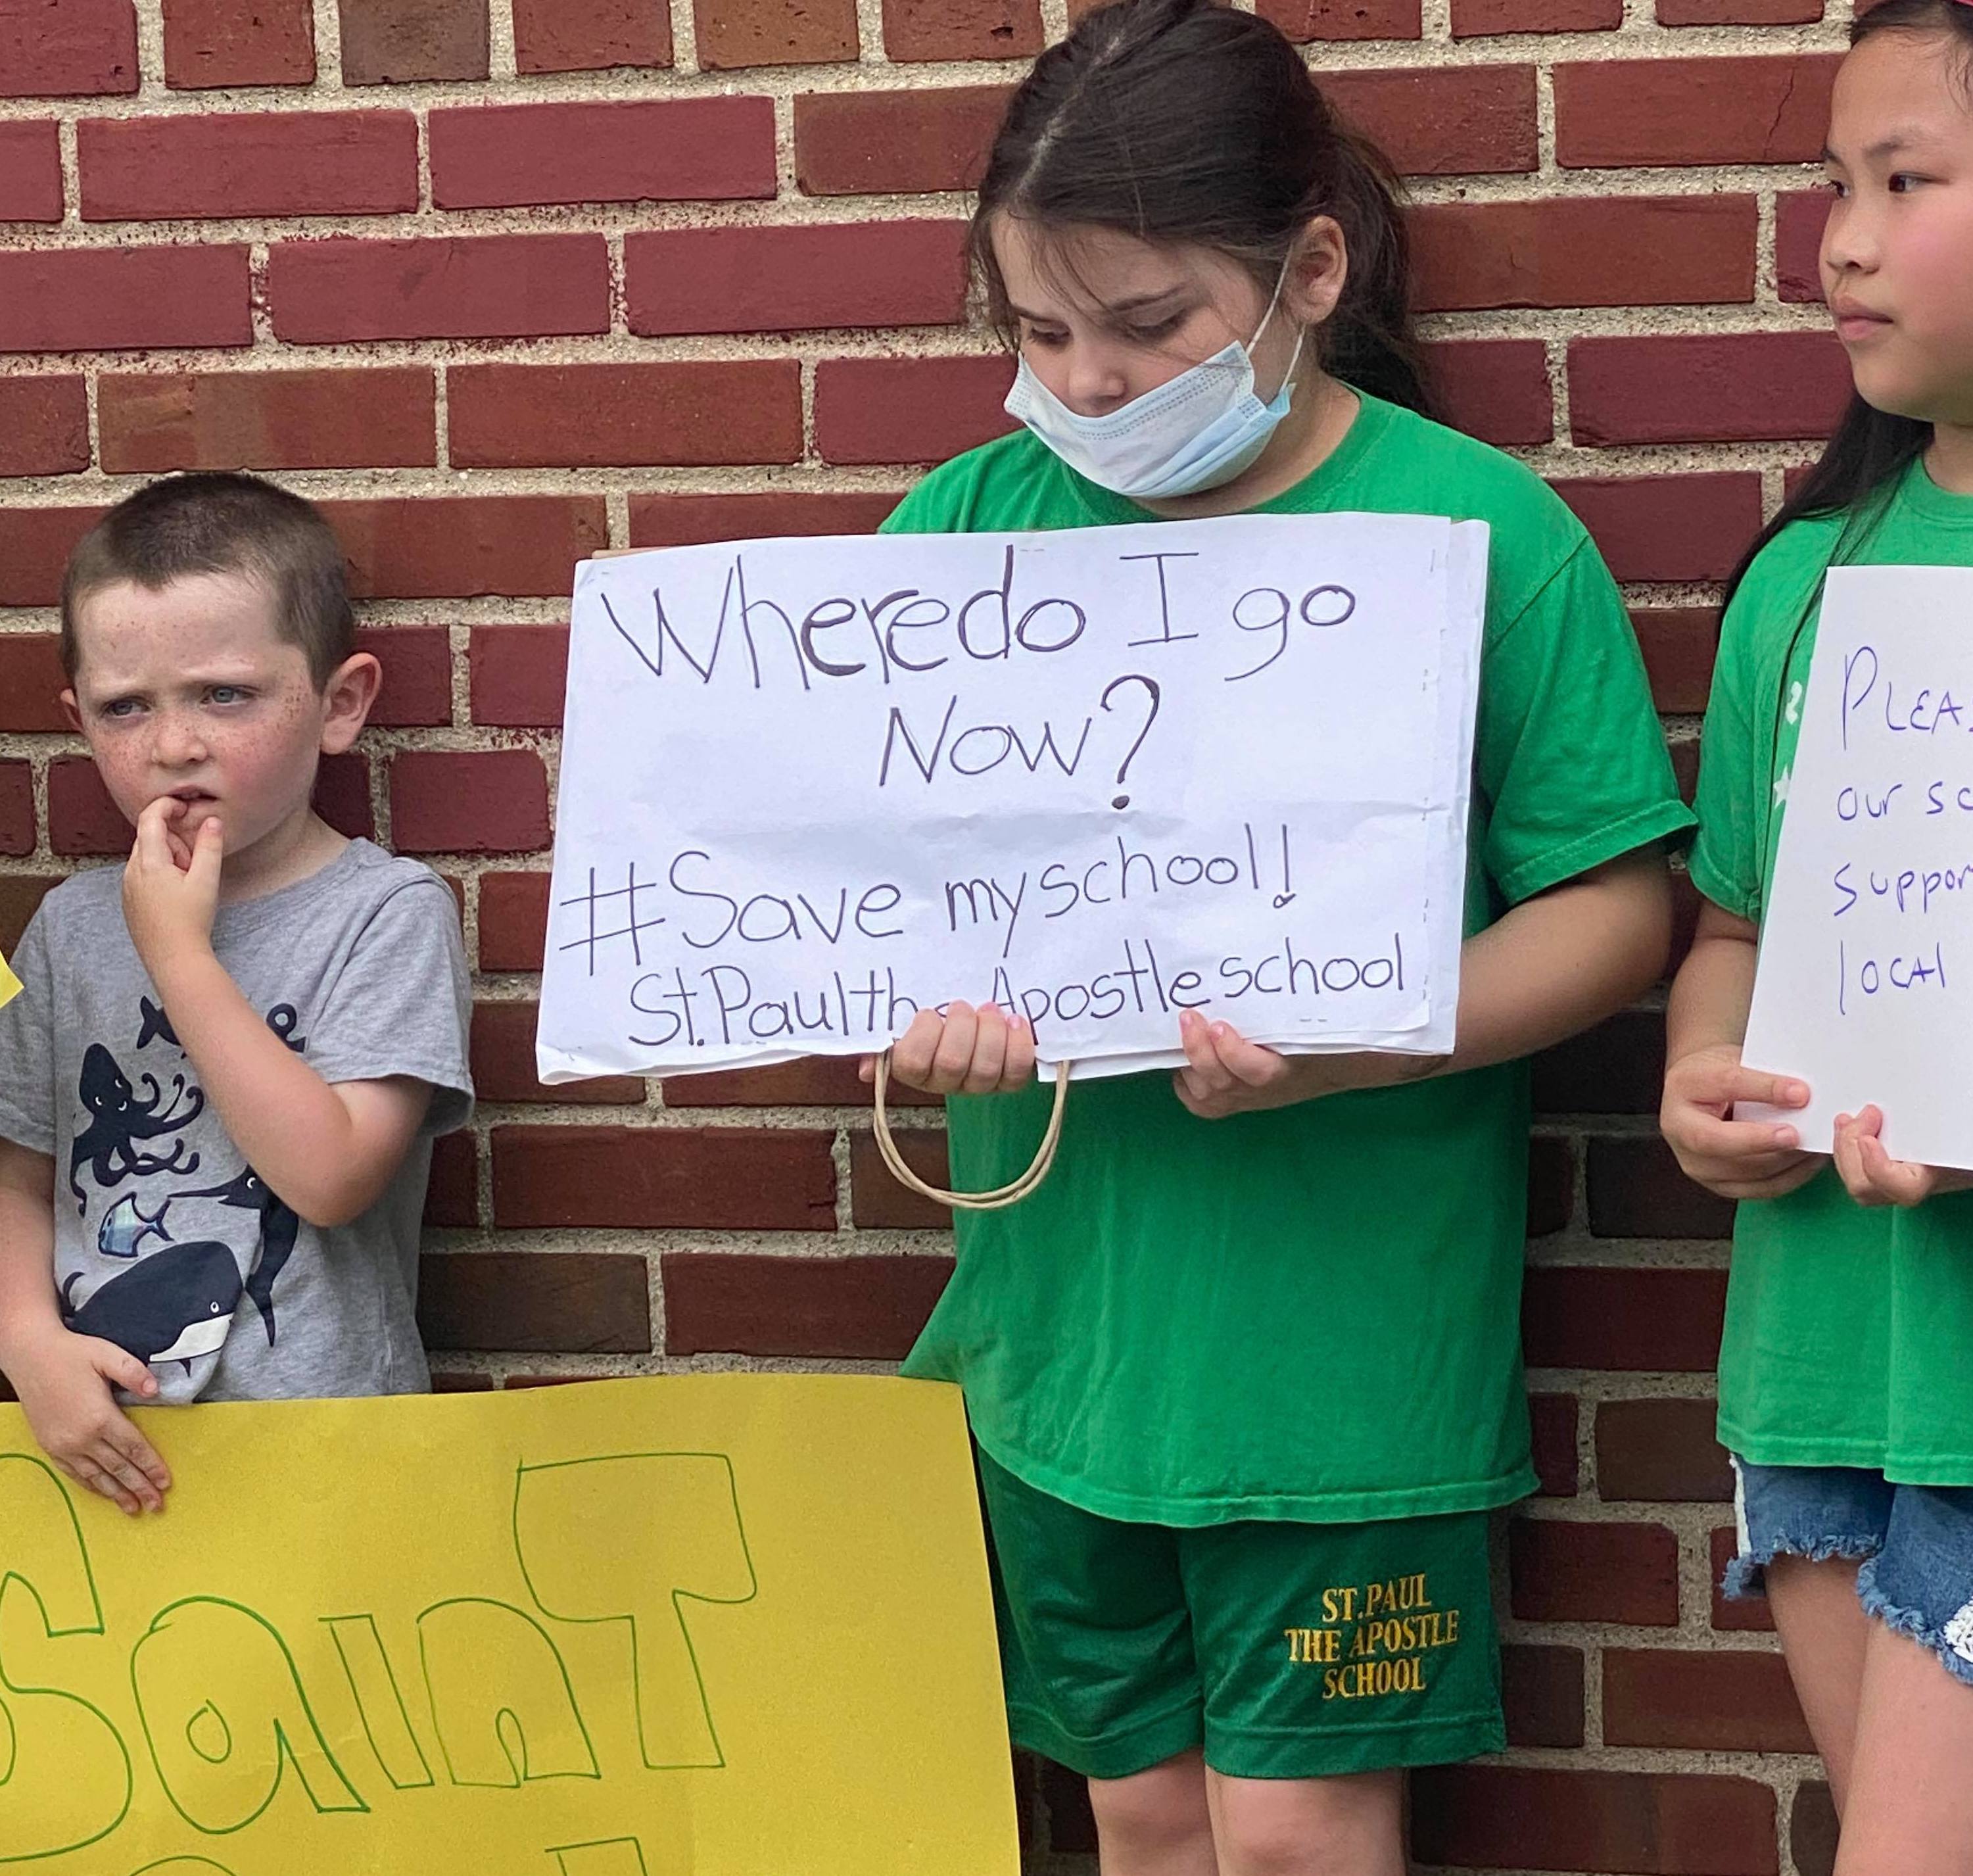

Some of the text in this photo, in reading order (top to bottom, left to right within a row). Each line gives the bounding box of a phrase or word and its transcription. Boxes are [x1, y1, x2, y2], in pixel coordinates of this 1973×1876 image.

[1119, 551, 1200, 647] I
[1224, 584, 1356, 682] go
[878, 674, 1160, 810] Now?
[1842, 645, 1973, 751] PLEA
[1283, 1610, 1460, 1662] THE APOSTLE
[1322, 1656, 1427, 1699] SCHOOL
